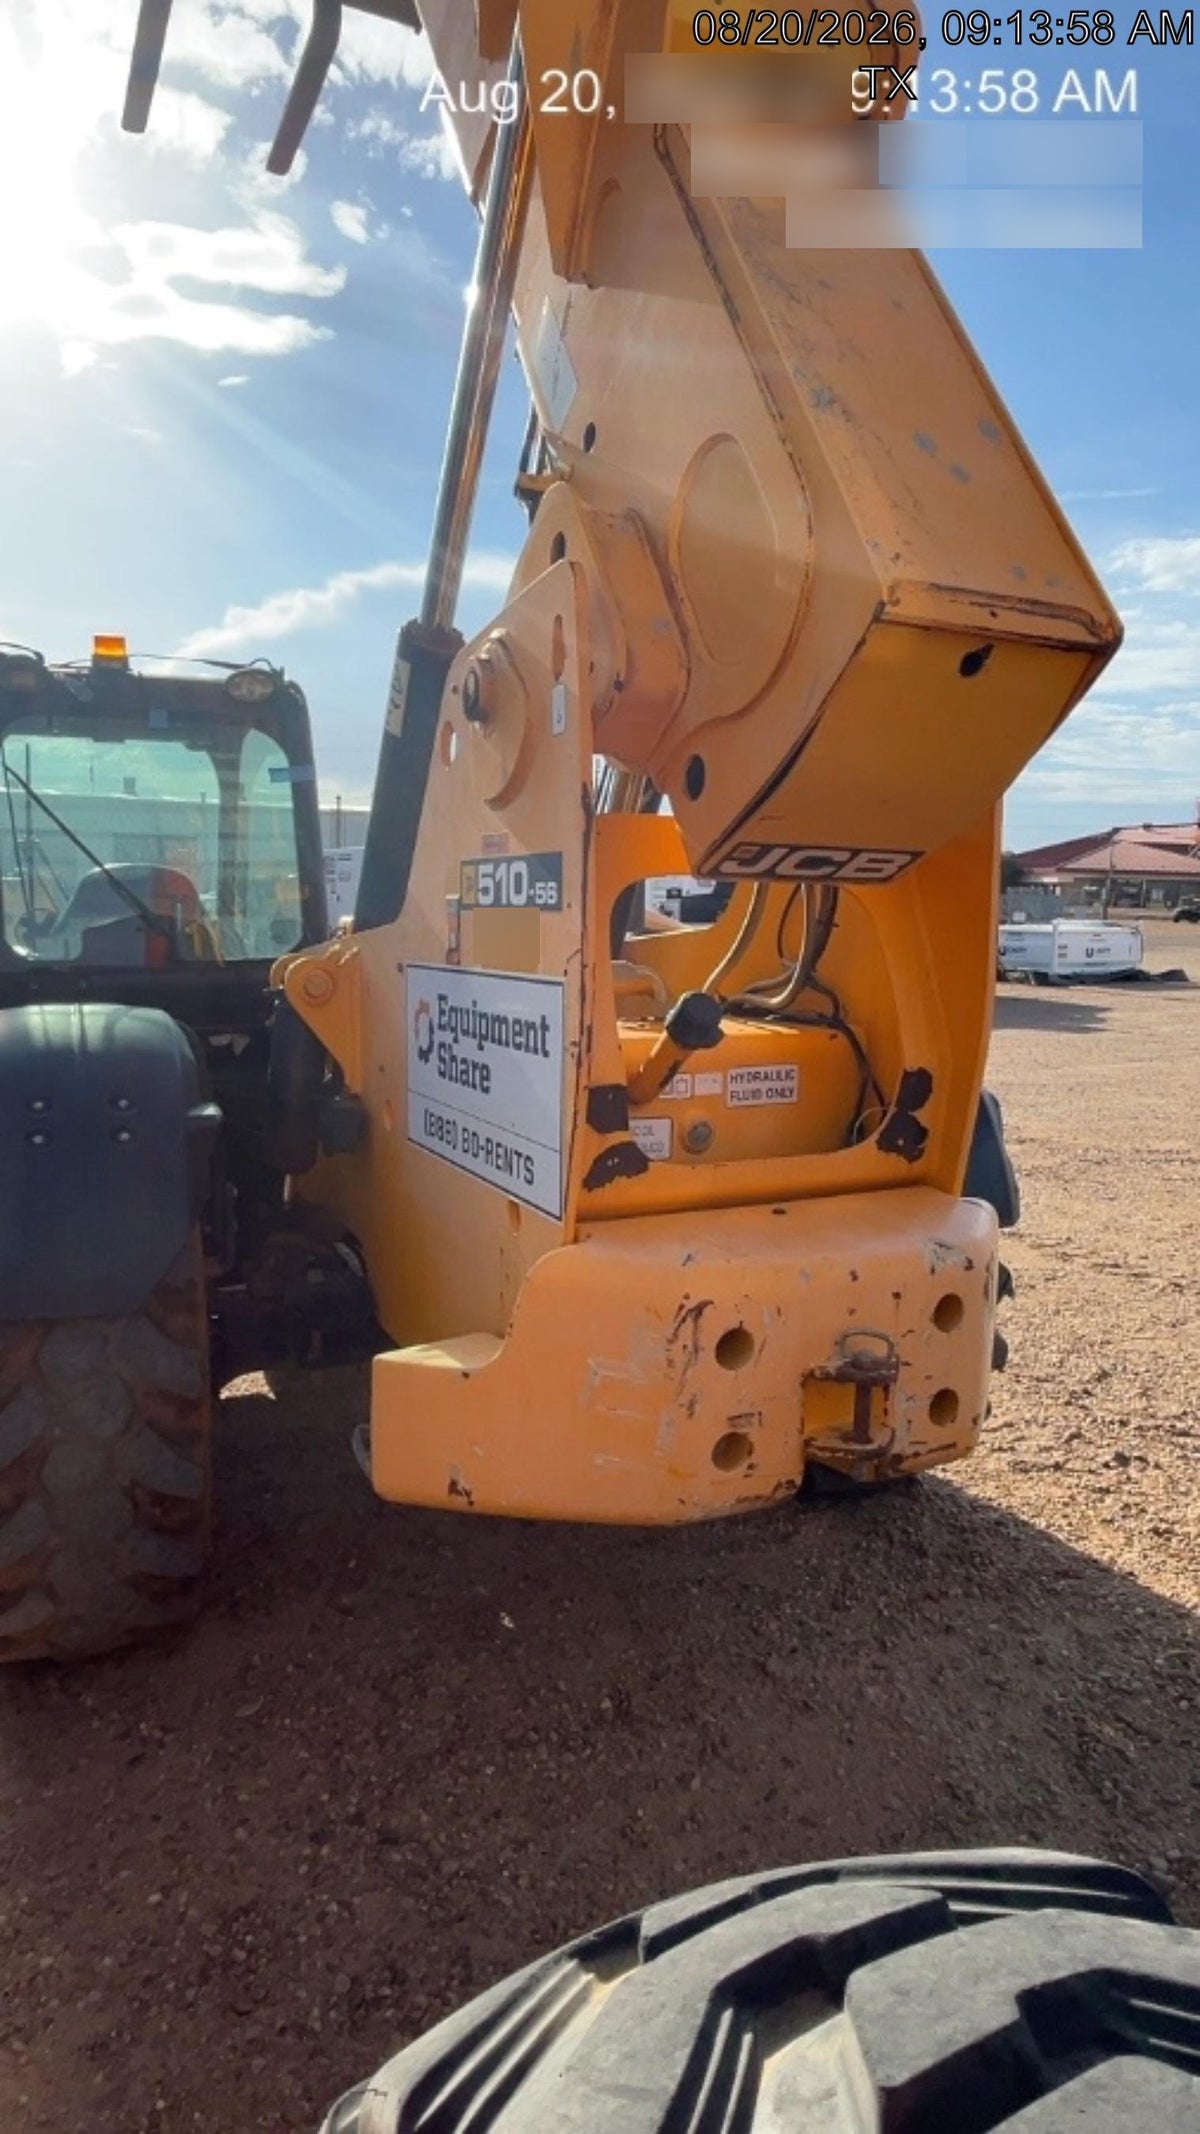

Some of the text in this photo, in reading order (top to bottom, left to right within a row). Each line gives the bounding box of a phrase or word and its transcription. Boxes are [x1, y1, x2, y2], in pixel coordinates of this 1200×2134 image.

[717, 845, 913, 880] JCB
[438, 993, 550, 1058] Equipment
[438, 1041, 491, 1094] Share
[730, 1069, 796, 1084] HYDRAULIC
[730, 1087, 795, 1102] FLUID ONLY
